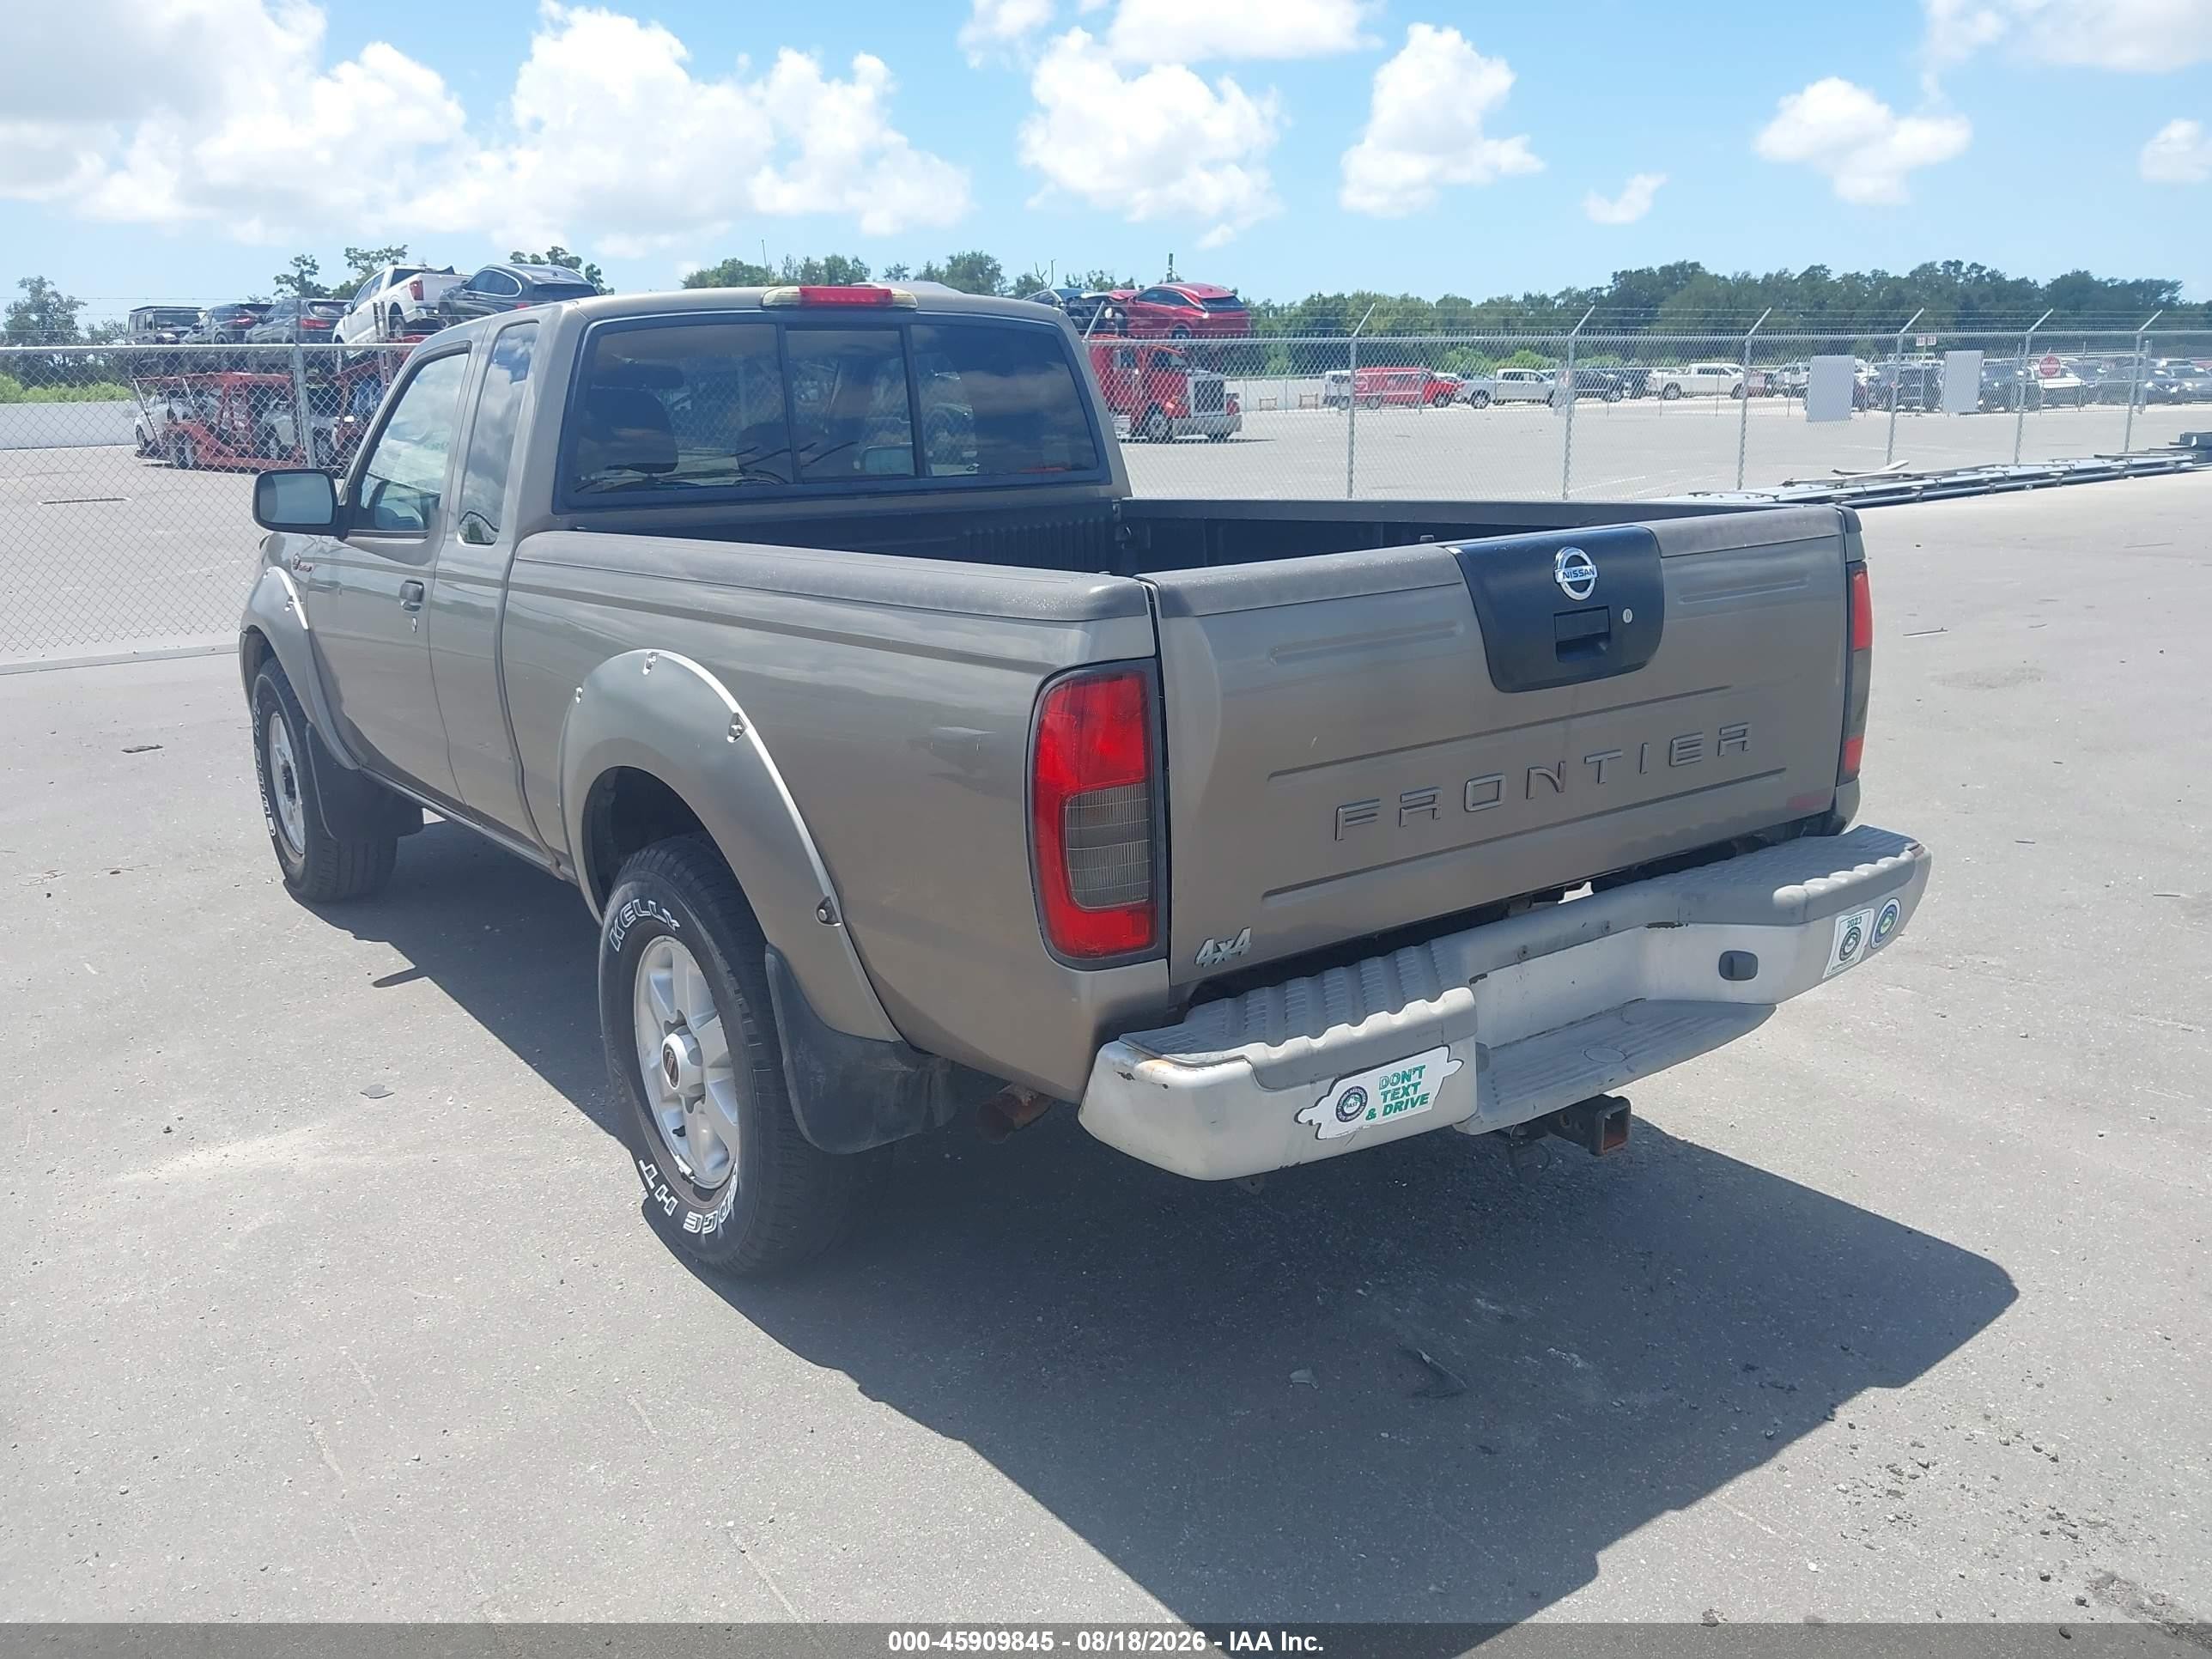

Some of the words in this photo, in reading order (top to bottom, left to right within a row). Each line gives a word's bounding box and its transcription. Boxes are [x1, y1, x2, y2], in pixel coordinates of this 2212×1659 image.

[1562, 567, 1595, 580] NISSAN
[1334, 721, 1750, 842] FRONTIER
[609, 898, 681, 952] KELLY
[1846, 915, 1863, 930] 2023
[1194, 927, 1251, 968] 4x4
[1379, 1064, 1426, 1091] DON'T
[1365, 1108, 1377, 1121] &
[1382, 1092, 1431, 1117] DRIVE
[1381, 1082, 1422, 1105] TEXT
